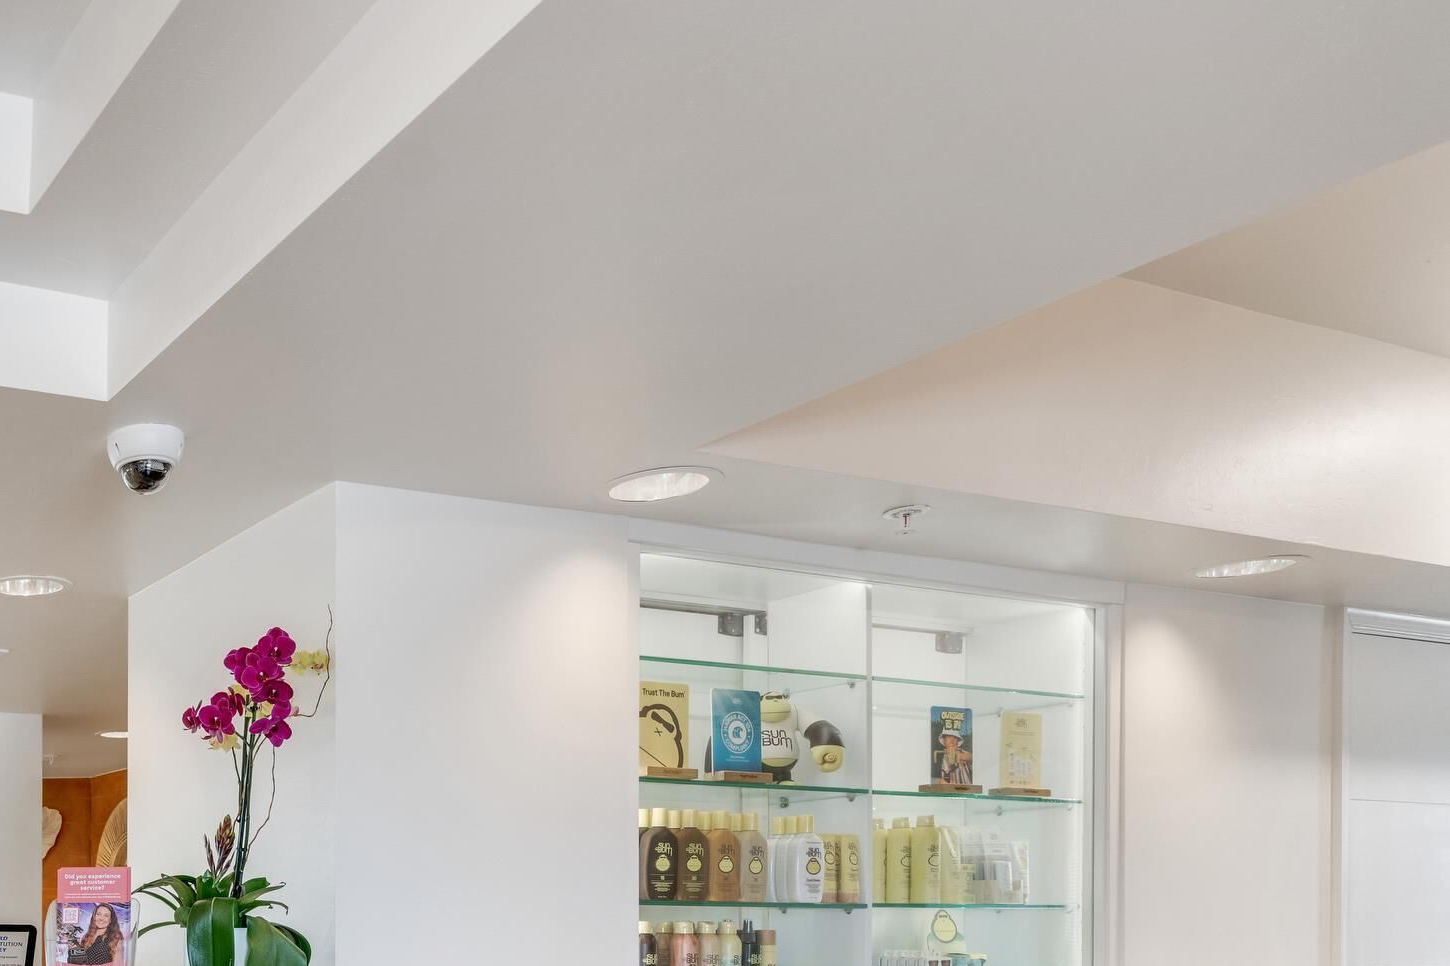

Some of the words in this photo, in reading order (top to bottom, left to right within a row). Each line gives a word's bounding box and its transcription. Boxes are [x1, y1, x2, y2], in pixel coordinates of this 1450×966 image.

[642, 688, 658, 696] Trust
[659, 689, 670, 697] The
[671, 690, 684, 698] Bum
